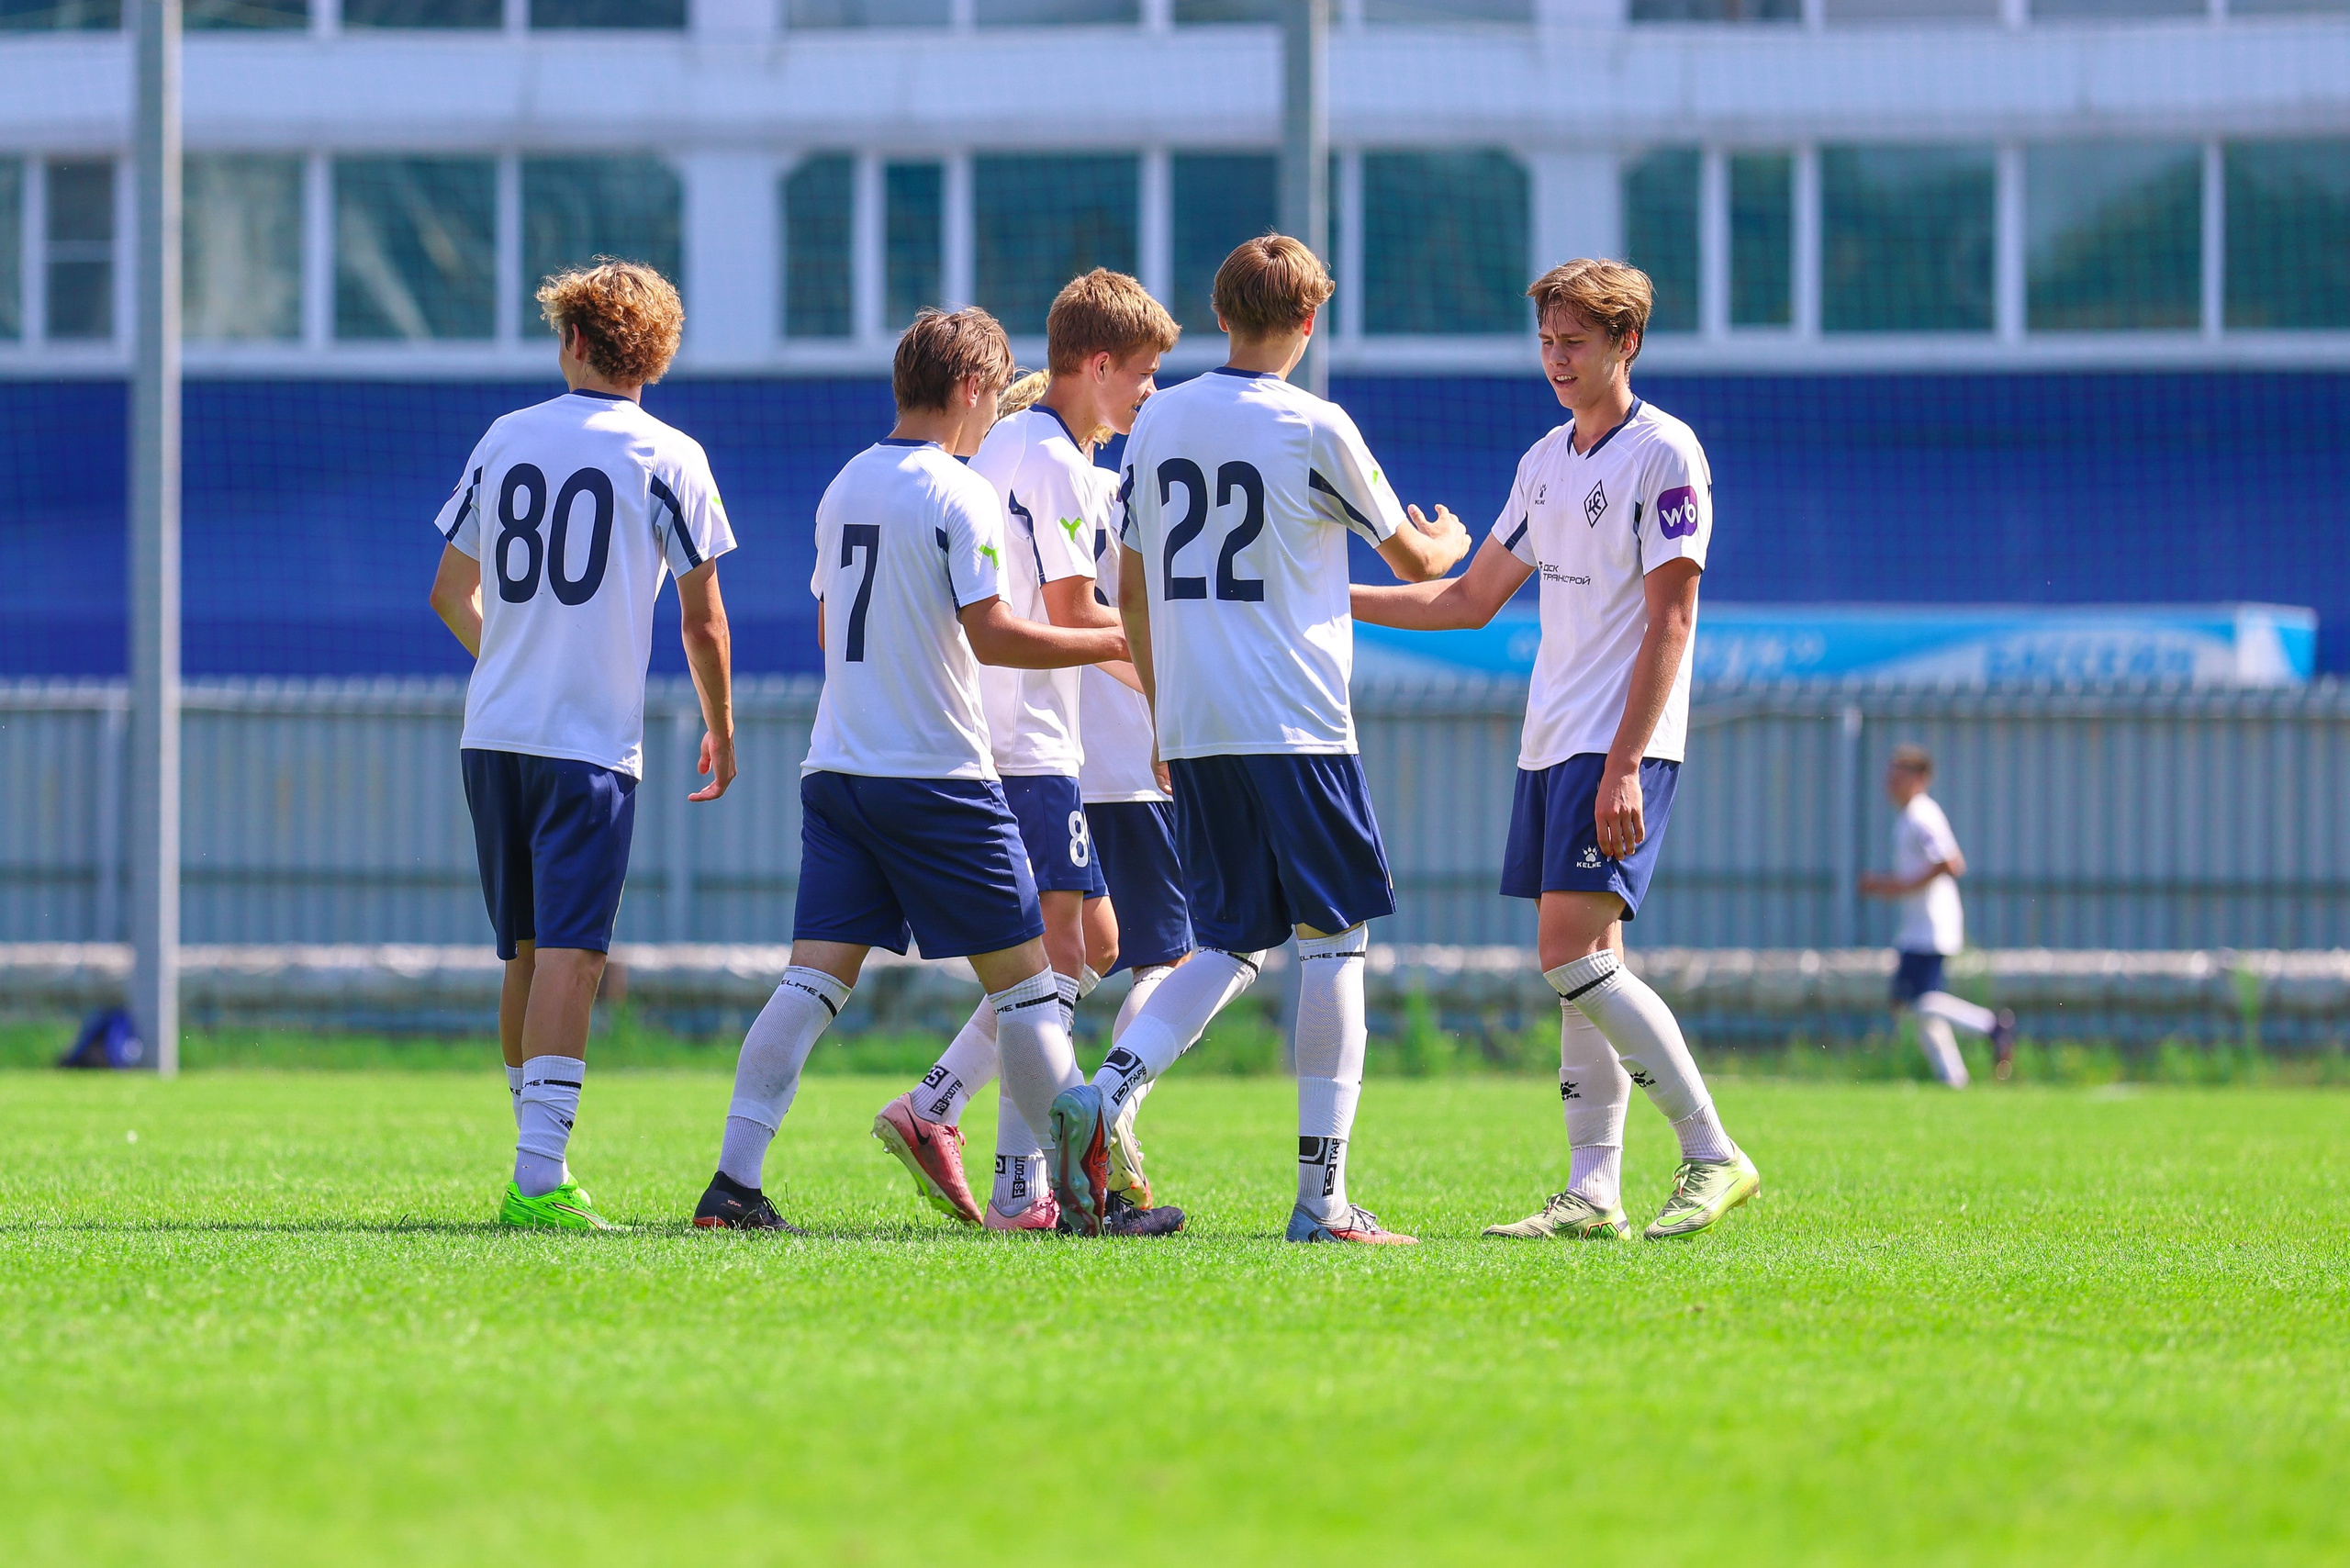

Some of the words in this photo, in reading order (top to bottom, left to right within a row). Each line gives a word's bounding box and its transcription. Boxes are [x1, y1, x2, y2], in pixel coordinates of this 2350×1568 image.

[496, 463, 613, 606] 80
[840, 524, 880, 662] 7
[1157, 457, 1266, 602] 22
[780, 979, 818, 996] ELME
[1300, 952, 1333, 961] ELME
